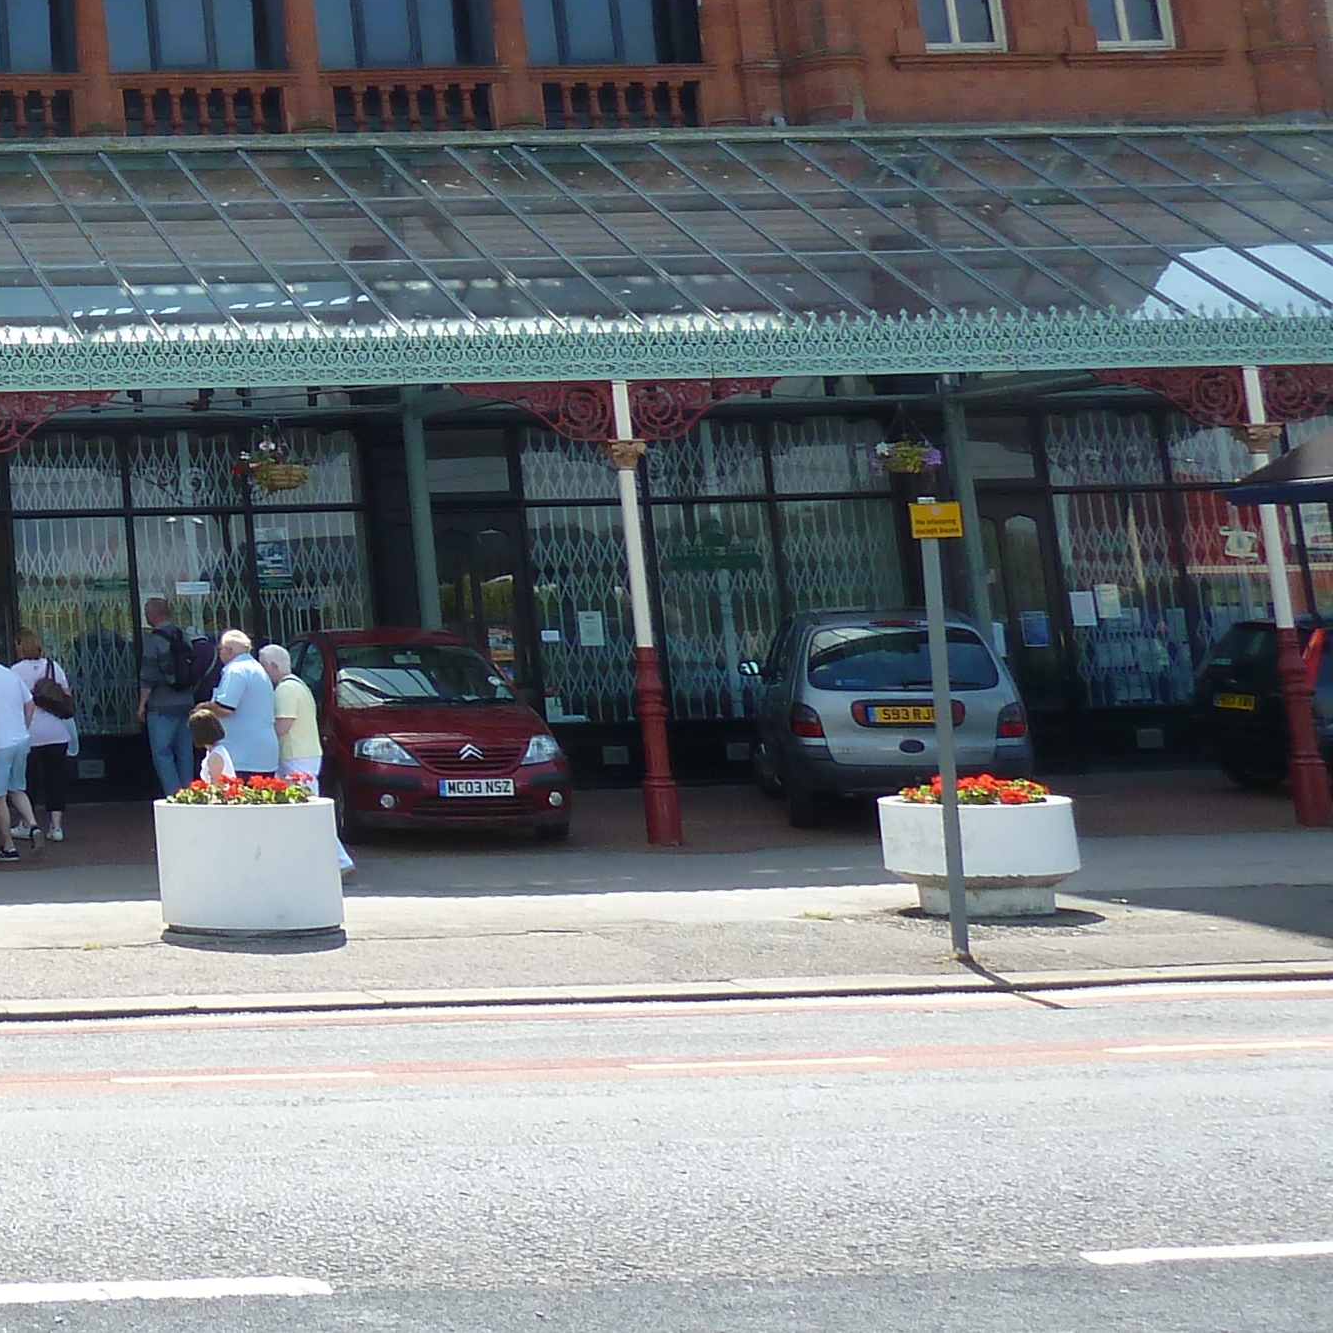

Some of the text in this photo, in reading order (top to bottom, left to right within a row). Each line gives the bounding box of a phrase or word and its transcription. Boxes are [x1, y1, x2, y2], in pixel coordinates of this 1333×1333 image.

[882, 708, 910, 720] S93
[448, 781, 511, 794] MC03 NSZ
